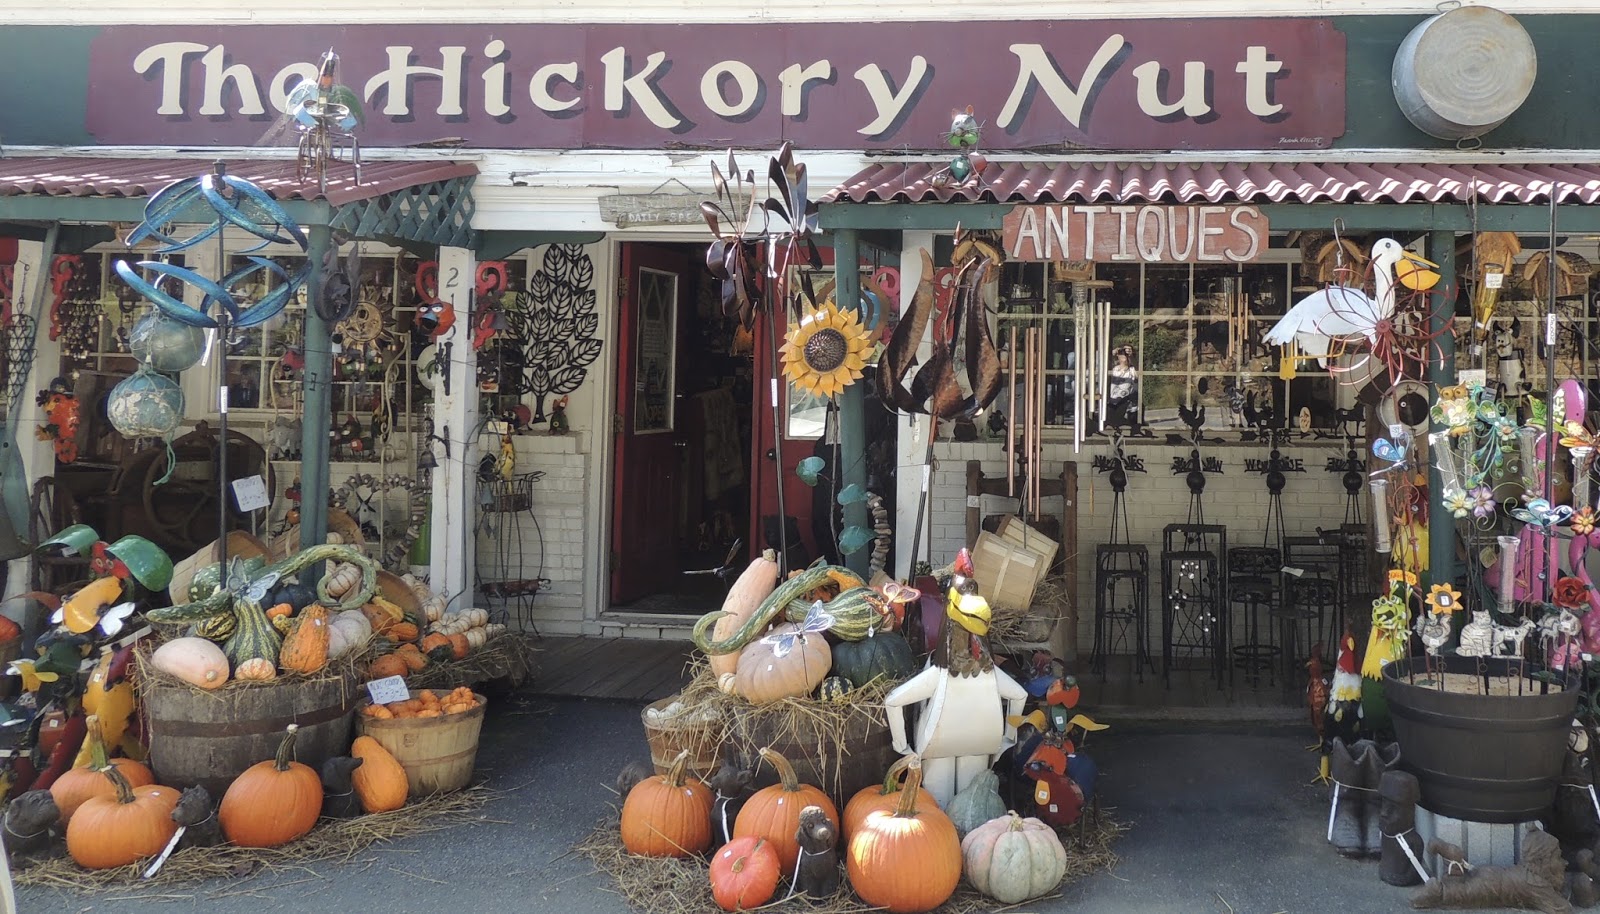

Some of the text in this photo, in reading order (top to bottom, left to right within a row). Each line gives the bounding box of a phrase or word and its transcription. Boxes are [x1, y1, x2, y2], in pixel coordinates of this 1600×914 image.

[365, 40, 927, 134] Hickory
[996, 34, 1283, 128] Nut
[1013, 206, 1258, 261] ANTIQUES
